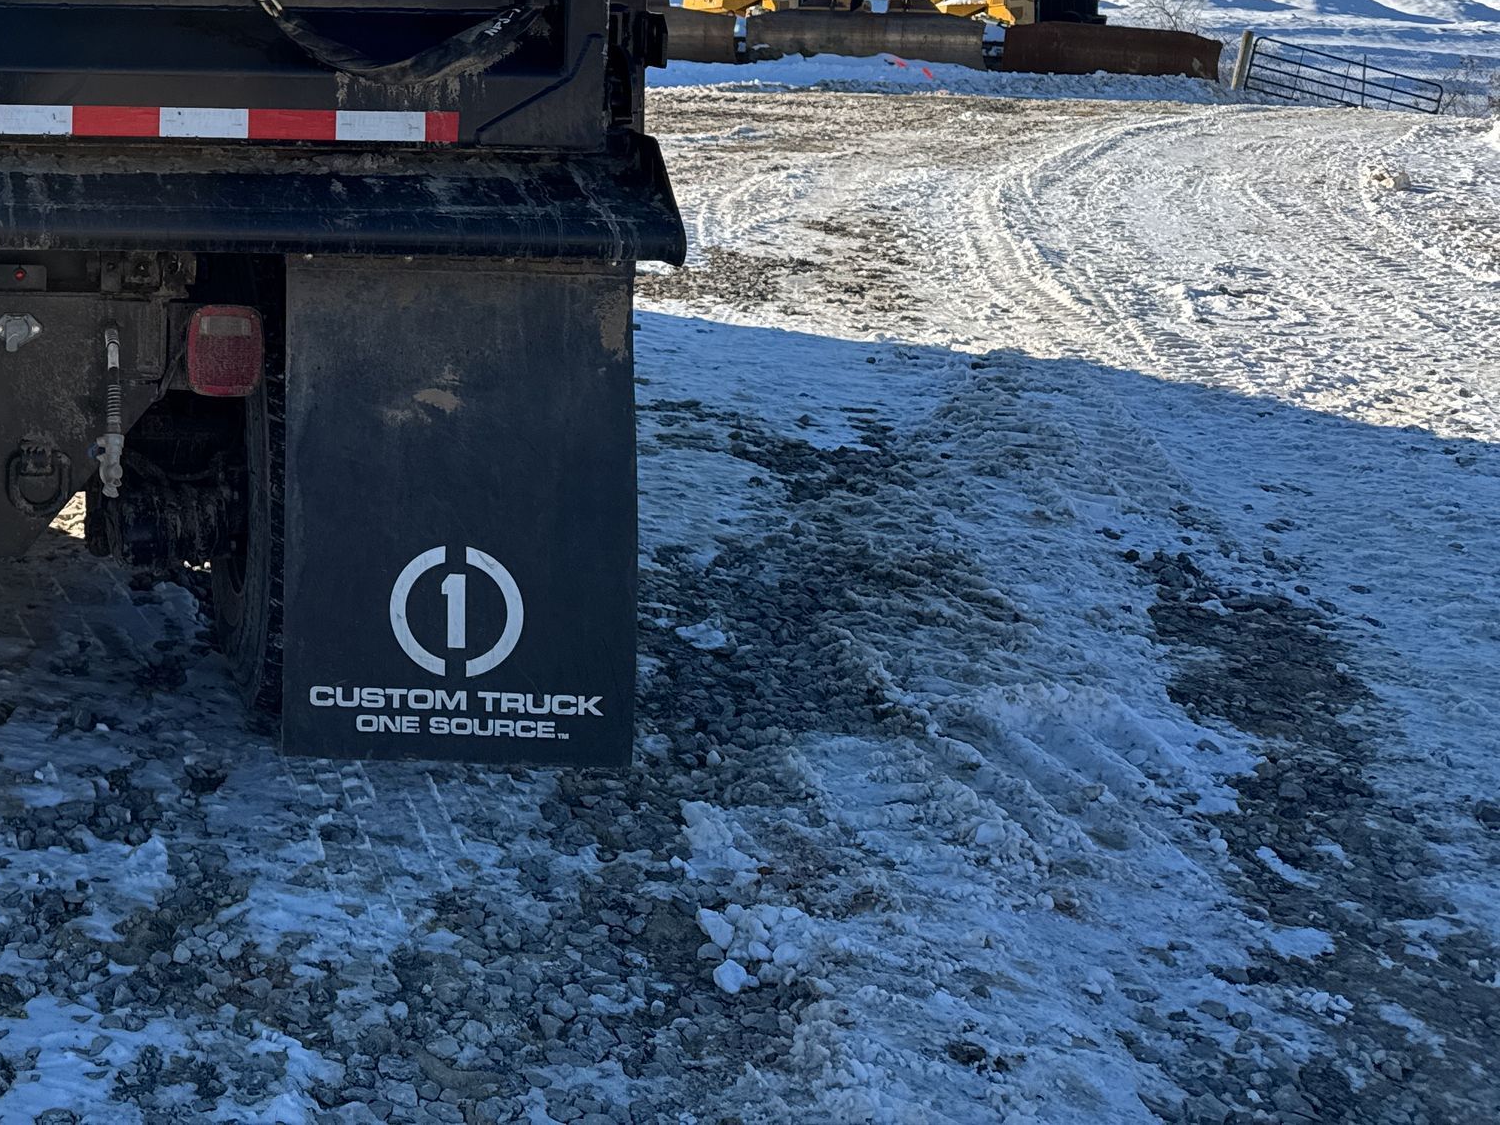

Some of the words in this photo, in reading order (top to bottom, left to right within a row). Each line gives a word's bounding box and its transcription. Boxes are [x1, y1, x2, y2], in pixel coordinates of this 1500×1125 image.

[441, 573, 467, 649] 1
[309, 685, 467, 711] CUSTOM
[477, 691, 604, 716] TRUCK
[355, 714, 420, 734] ONE
[429, 716, 556, 739] SOURCE
